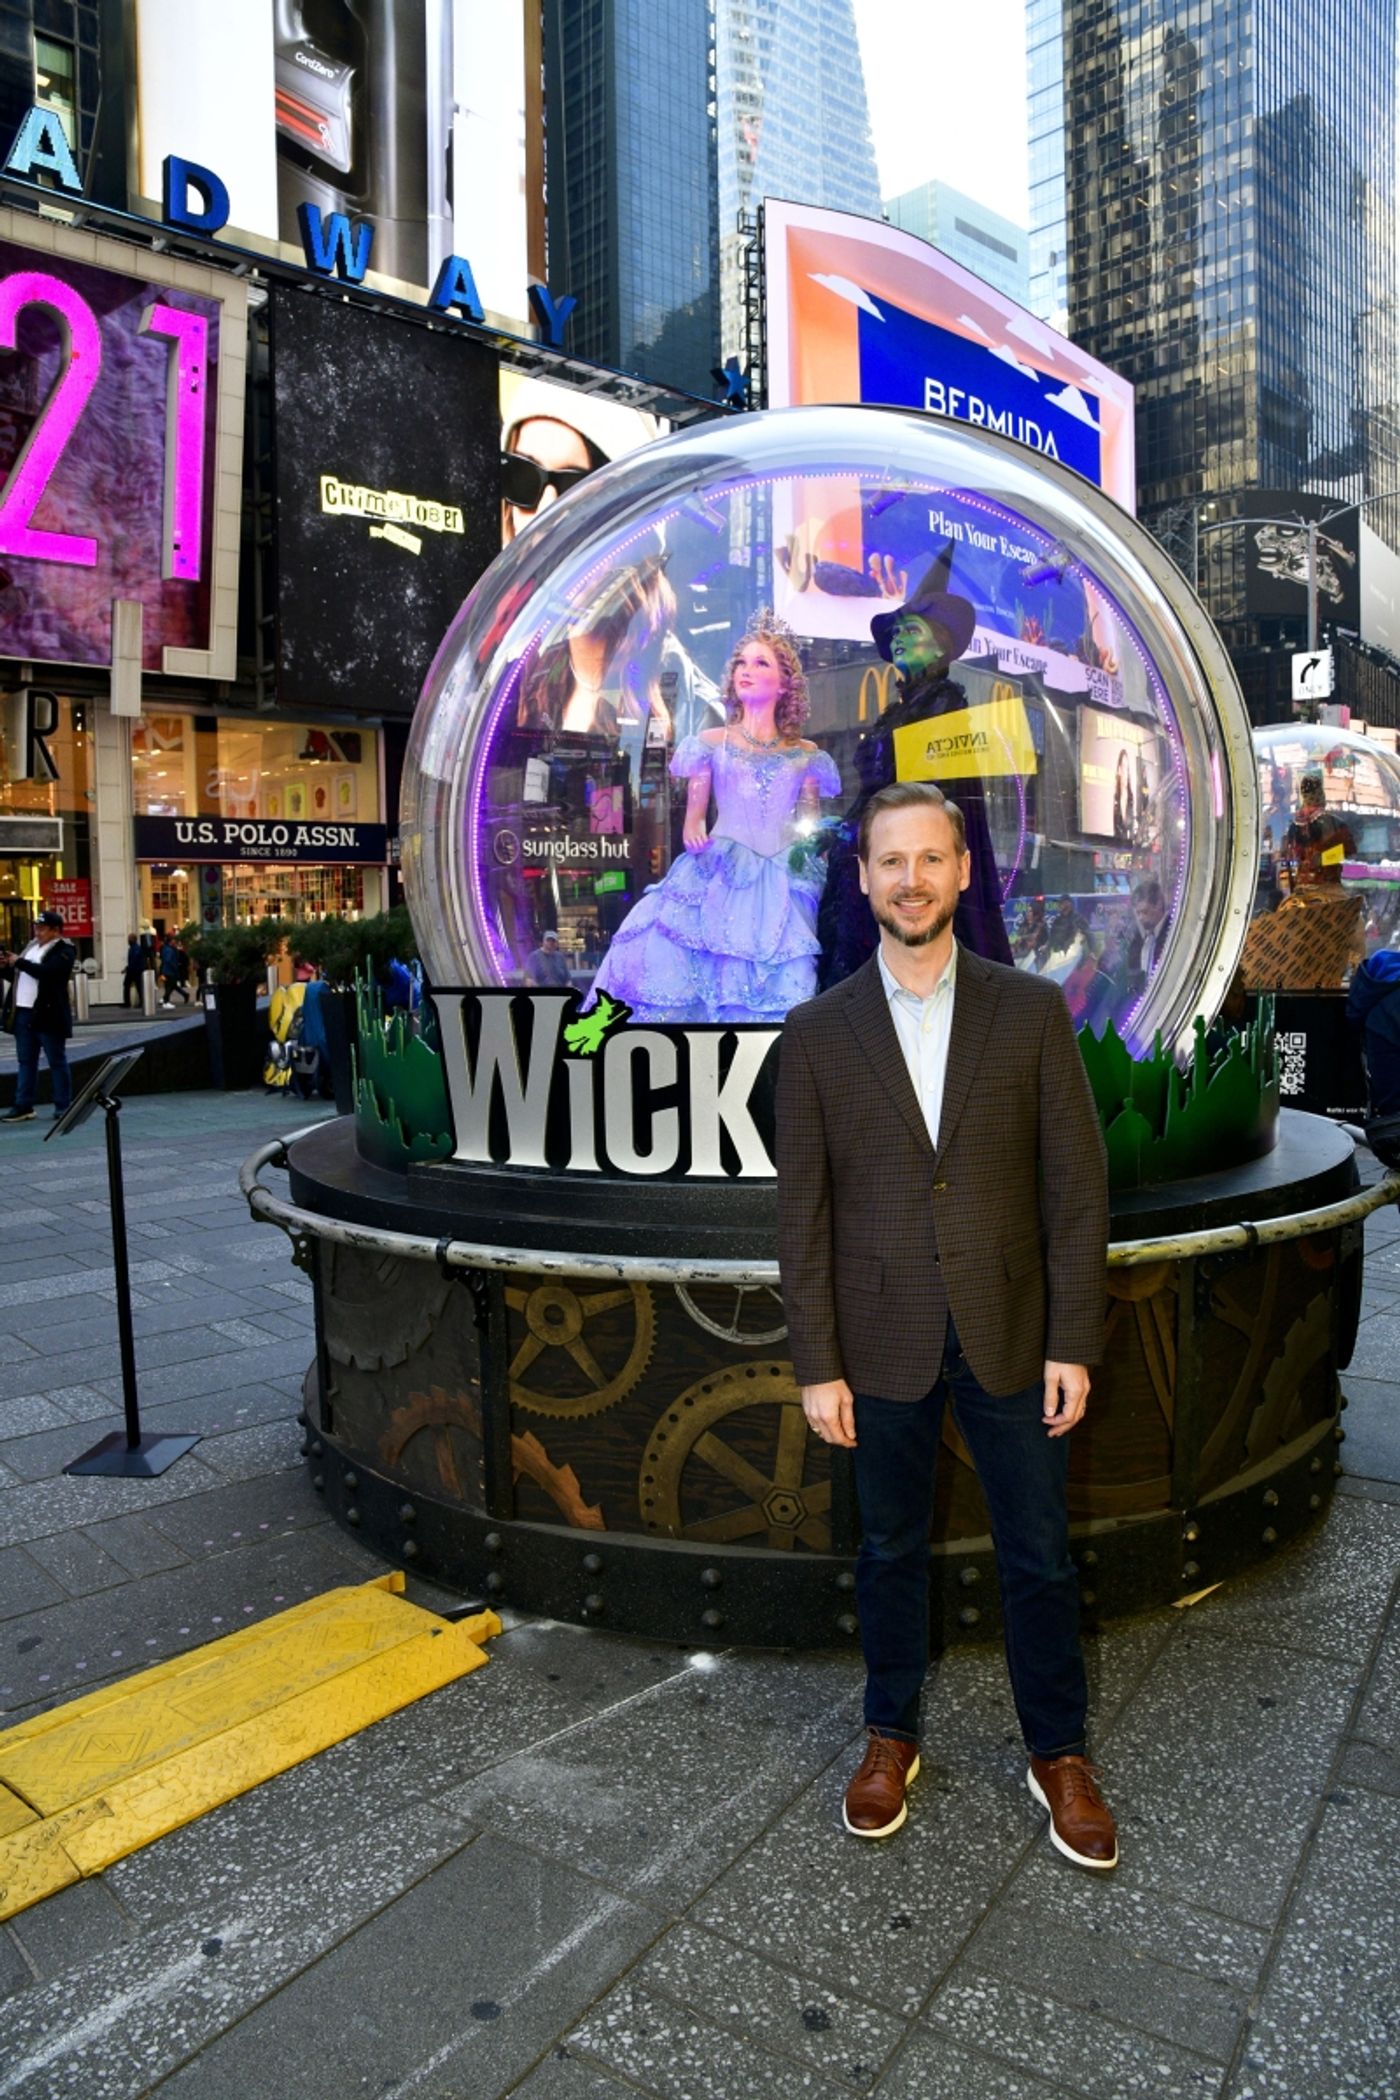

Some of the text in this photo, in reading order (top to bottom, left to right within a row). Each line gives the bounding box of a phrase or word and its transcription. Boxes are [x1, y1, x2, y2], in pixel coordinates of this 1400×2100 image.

[295, 52, 335, 79] CordZero
[0, 271, 208, 582] 21
[924, 376, 1060, 461] BERMUDA
[928, 509, 1040, 567] Plan Your Escap
[1085, 667, 1109, 688] SCAN
[26, 688, 60, 780] R
[175, 822, 360, 847] U.S. POLO ASSN.
[522, 834, 630, 863] sunglass hut
[240, 847, 298, 858] SINCE 1890
